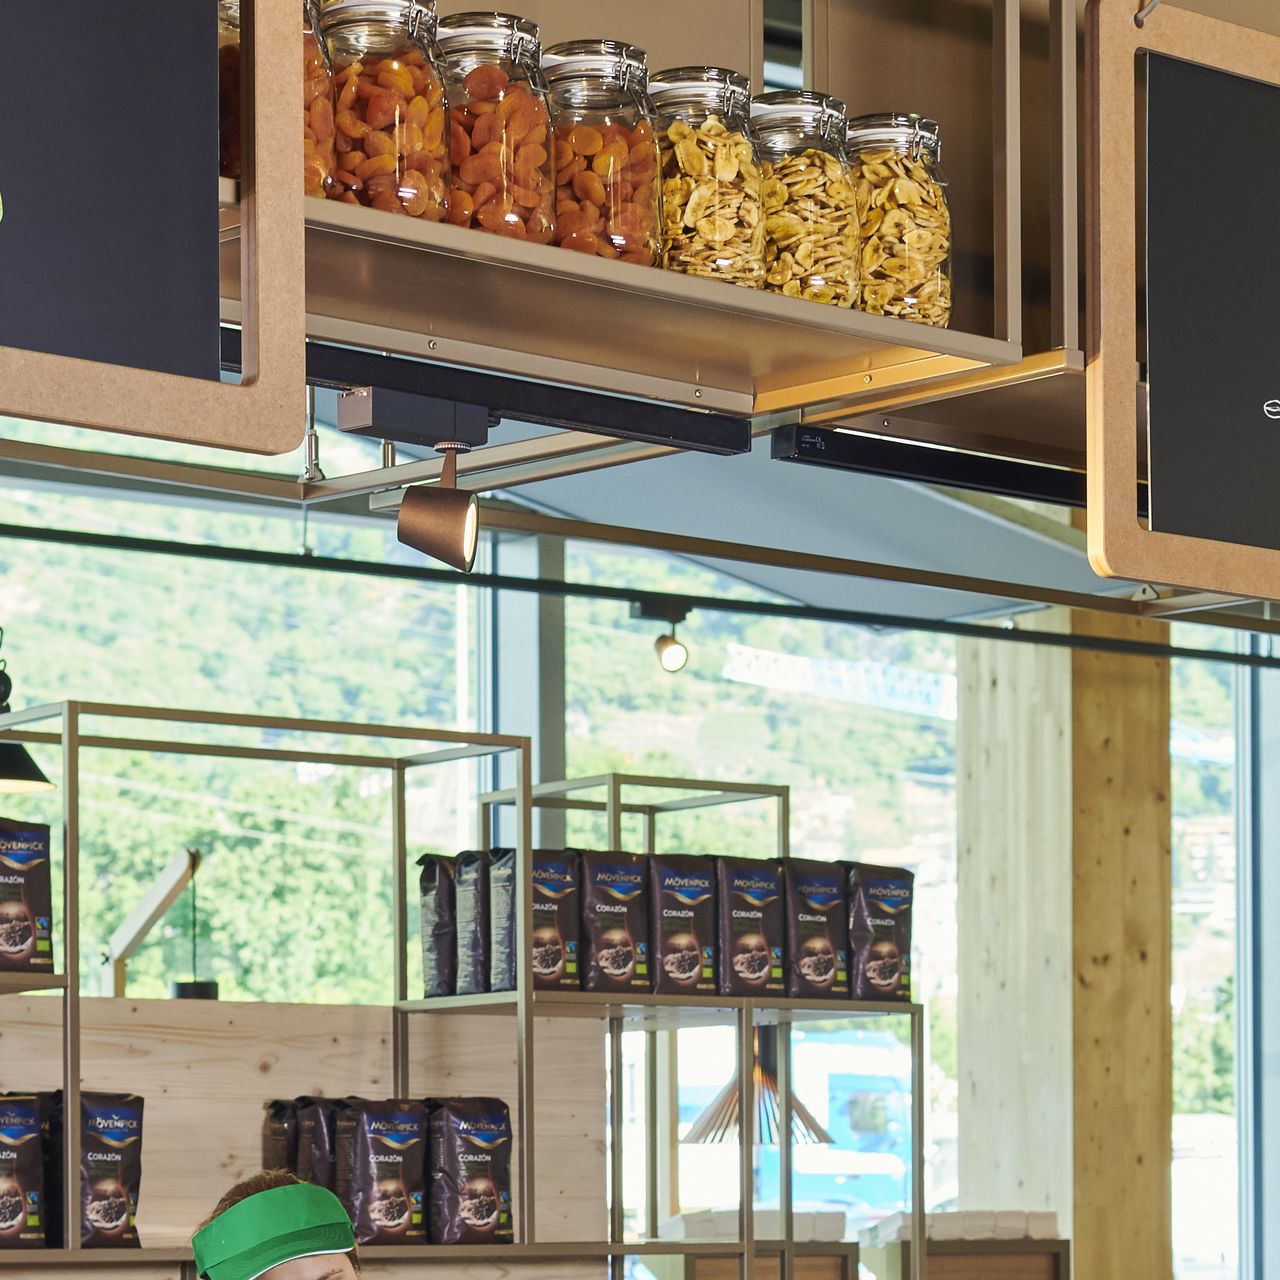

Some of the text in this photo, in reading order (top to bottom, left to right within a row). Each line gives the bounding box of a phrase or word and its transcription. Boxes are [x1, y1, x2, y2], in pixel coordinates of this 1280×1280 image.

[532, 902, 558, 912] ORAZÓN
[596, 903, 628, 913] CORAZÓN
[663, 908, 694, 918] CORAZÓN
[732, 909, 763, 919] CORAZÓN
[87, 1152, 122, 1162] CORAZÓN
[369, 1153, 403, 1163] CORAZÓN
[458, 1153, 491, 1163] CORAZÓN
